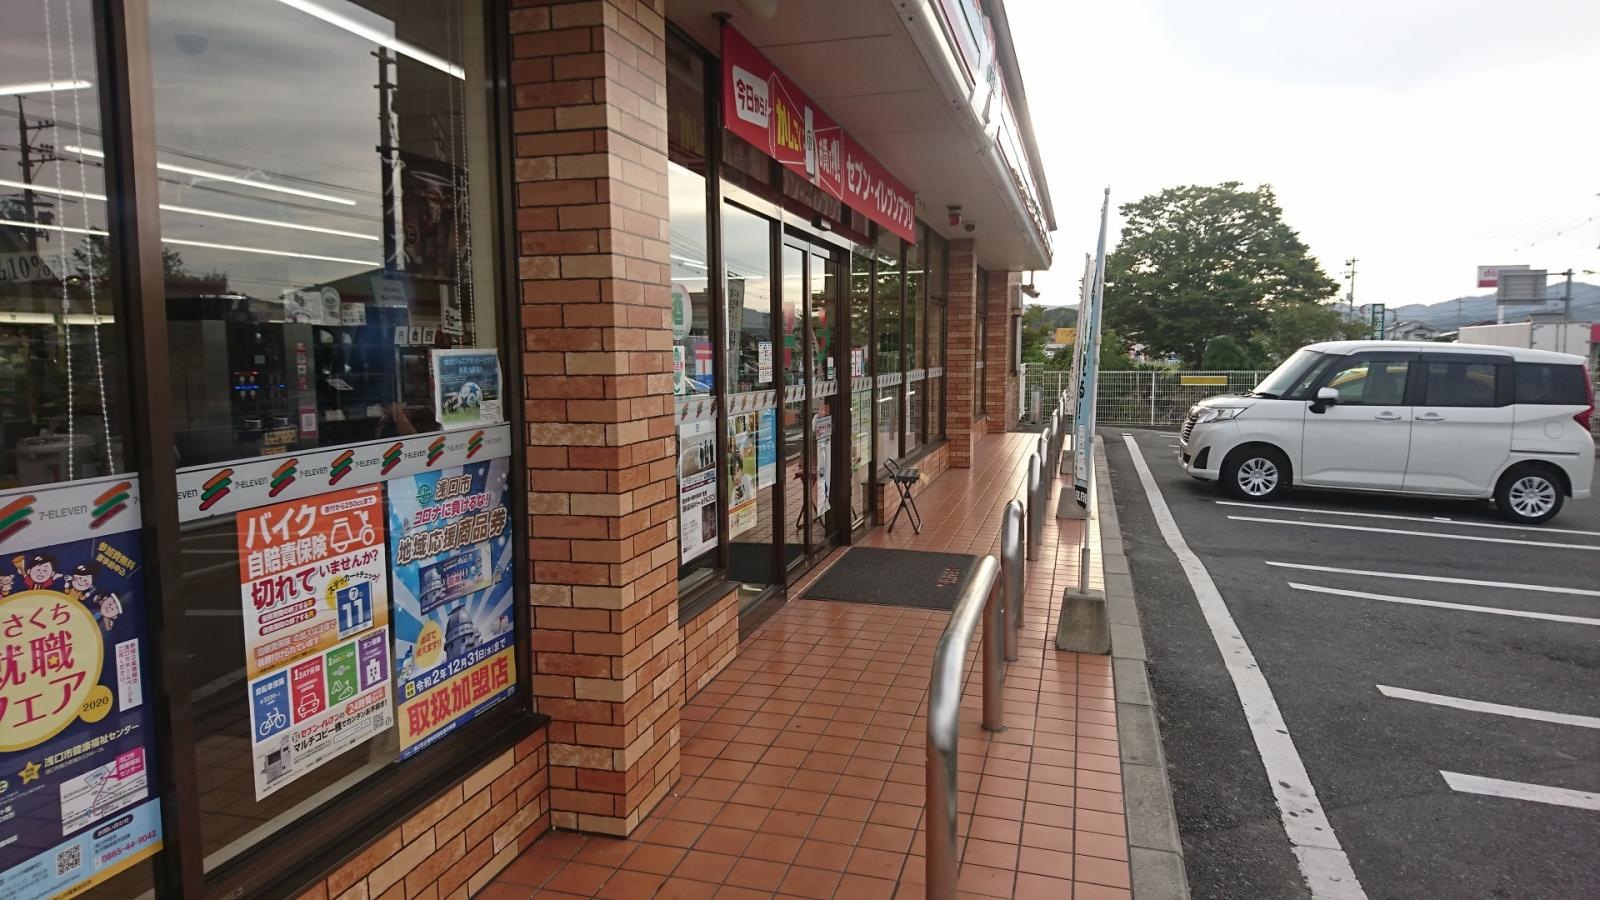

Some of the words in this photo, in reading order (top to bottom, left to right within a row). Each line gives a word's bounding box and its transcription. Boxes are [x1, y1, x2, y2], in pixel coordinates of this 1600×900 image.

[736, 78, 768, 118] 今日から!
[434, 474, 472, 500] 浅口市
[246, 503, 317, 549] バイク
[413, 492, 491, 527] コロナに負けるな!
[247, 533, 328, 579] 自賠責保険
[396, 507, 507, 565] 地域応援商品券
[342, 598, 366, 628] 11
[0, 671, 87, 728] ェア
[82, 695, 110, 714] 2020
[406, 655, 509, 738] 取扱加盟店
[44, 723, 141, 767] 浅口市健康福祉センター
